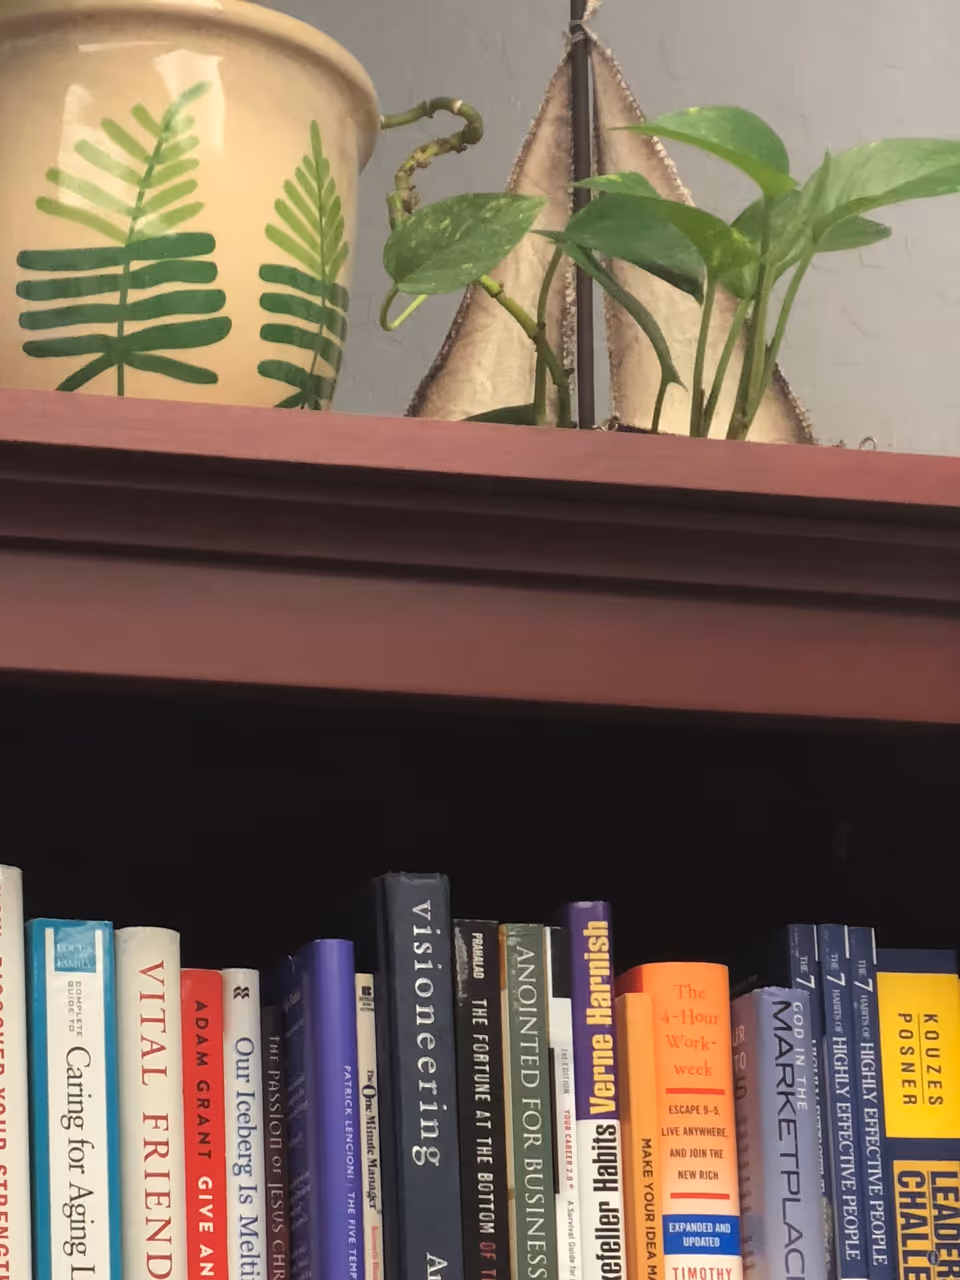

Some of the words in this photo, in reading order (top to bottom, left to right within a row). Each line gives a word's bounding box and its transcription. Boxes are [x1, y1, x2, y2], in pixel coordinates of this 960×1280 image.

[472, 932, 485, 979] PRAHALAD
[584, 920, 612, 1025] Harnish
[139, 960, 168, 1086] VITAL
[195, 1000, 209, 1067] ADAM
[412, 900, 448, 1166] visioneering
[516, 945, 540, 1088] ANOINTED
[235, 1037, 255, 1082] Our
[589, 1033, 616, 1116] Verne
[898, 1013, 917, 1105] POSNER
[923, 1013, 944, 1105] KOUZES
[60, 1046, 92, 1131] Caring
[344, 1065, 352, 1115] PATRICK
[668, 1105, 701, 1115] ESCAPE
[196, 1080, 212, 1159] GRANT
[232, 1091, 257, 1177] Iceberg
[521, 1097, 542, 1150] FOR
[68, 1138, 95, 1174] for
[345, 1120, 356, 1179] LENCIONI
[641, 1138, 653, 1177] MAKE
[670, 1148, 687, 1158] AND
[689, 1148, 707, 1158] JOIN
[710, 1148, 724, 1159] THE
[678, 1170, 696, 1180] NEW
[699, 1170, 719, 1180] RICH
[61, 1181, 95, 1257] Aging
[198, 1175, 214, 1233] GIVE
[238, 1184, 257, 1205] Is
[524, 1157, 548, 1280] BUSINESS
[643, 1182, 655, 1223] YOUR
[645, 1226, 657, 1261] IDEA
[669, 1222, 713, 1233] EXPANDED
[715, 1222, 731, 1233] AND
[683, 1236, 720, 1247] UPDATED
